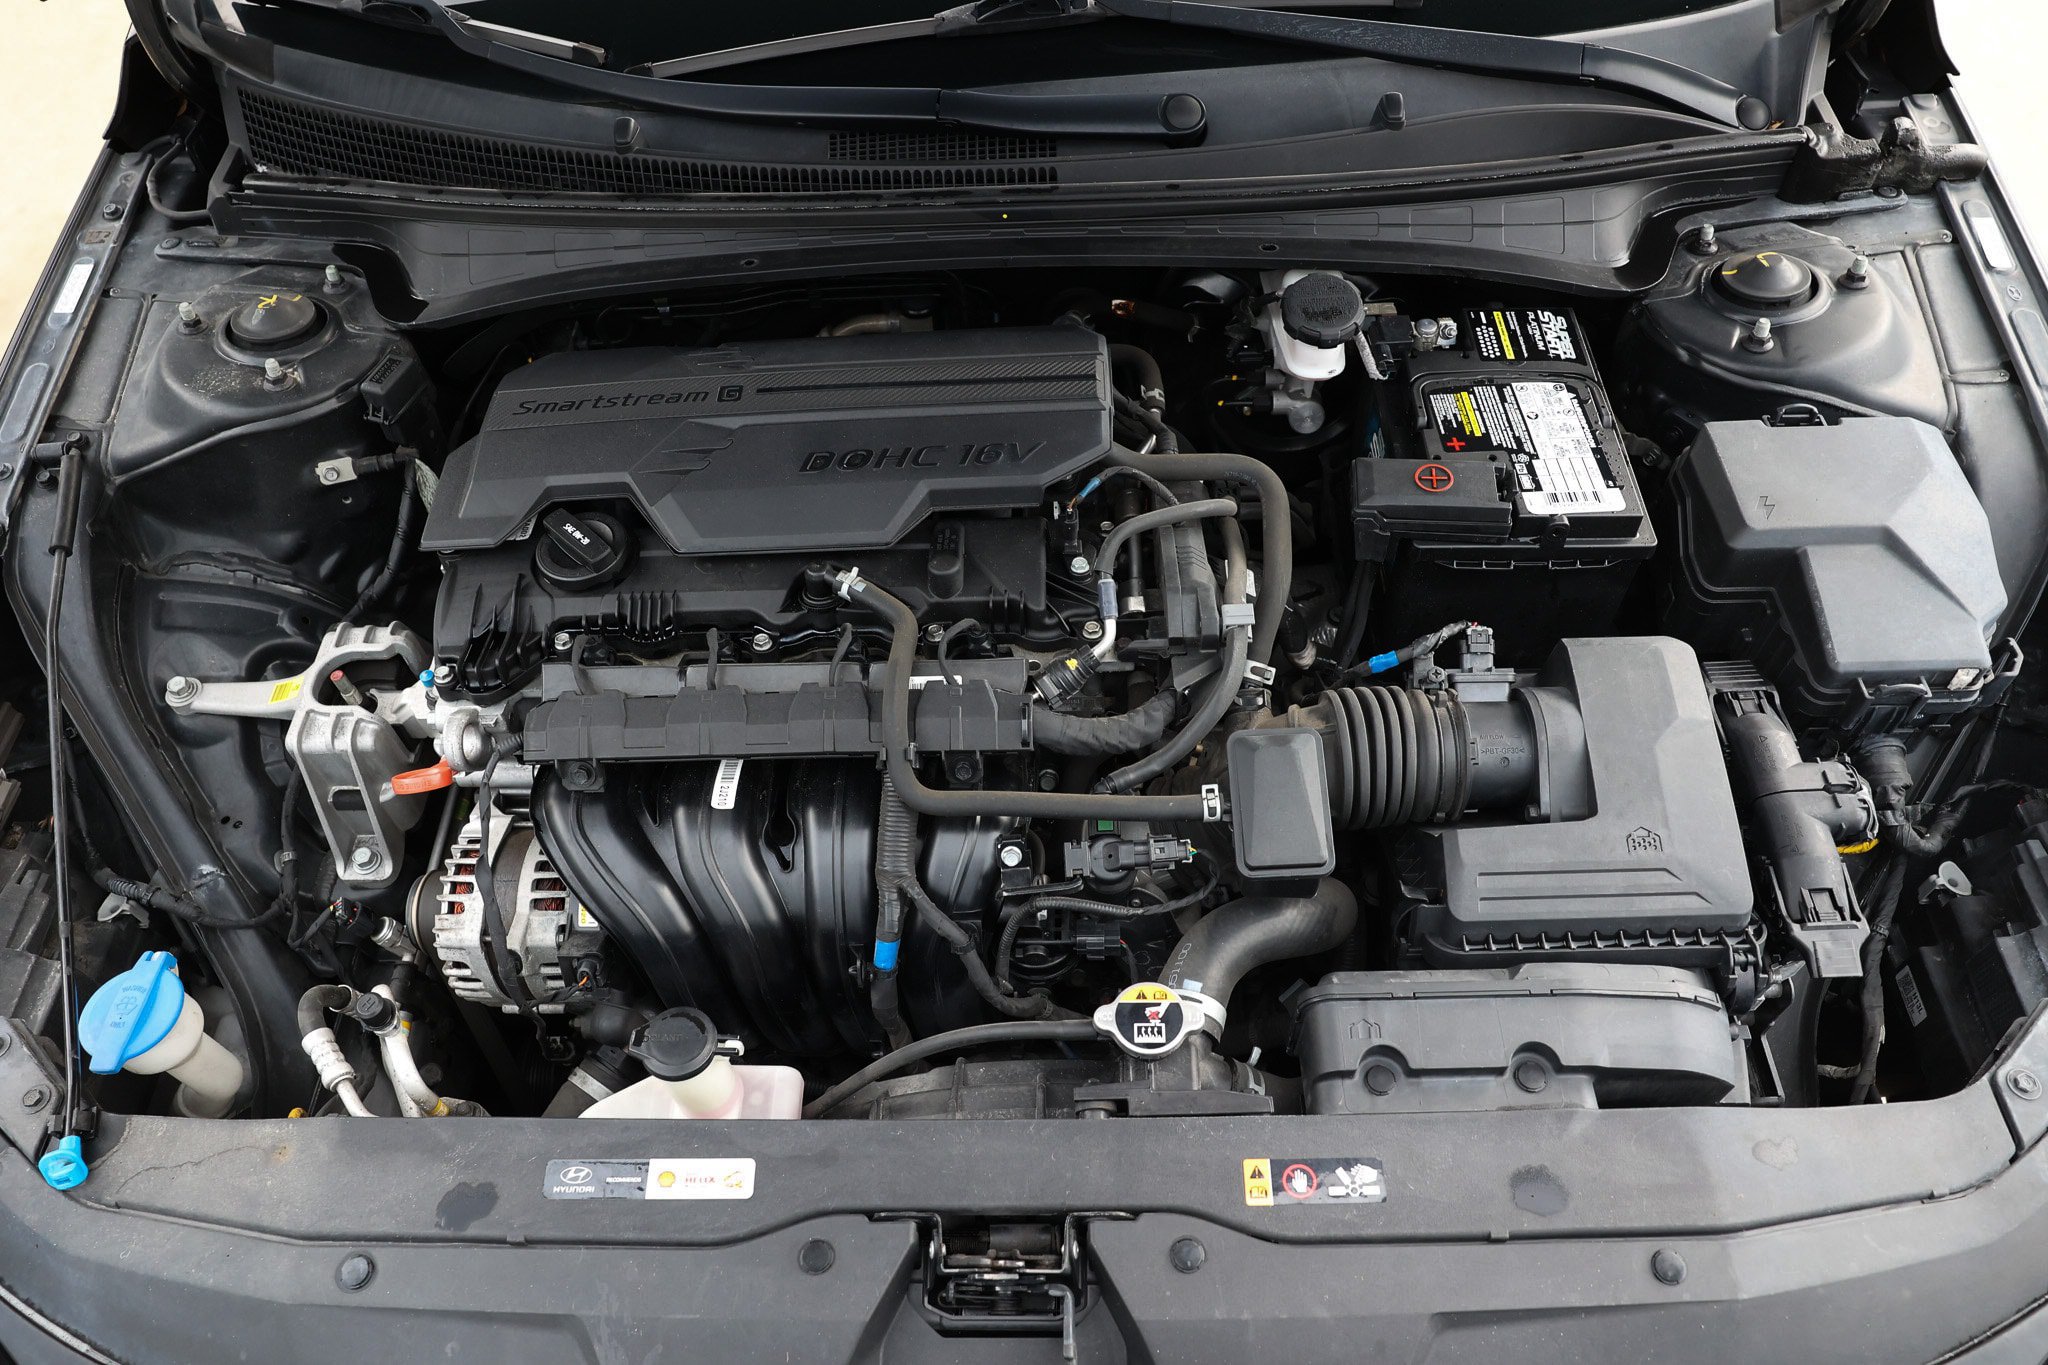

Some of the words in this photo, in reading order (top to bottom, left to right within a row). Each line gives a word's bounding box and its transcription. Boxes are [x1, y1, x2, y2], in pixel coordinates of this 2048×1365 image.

[1526, 311, 1546, 351] PLATINUM
[1537, 310, 1564, 359] START
[1555, 316, 1576, 360] SUPER
[512, 390, 709, 416] Smartstream
[800, 444, 949, 474] DOHC
[957, 440, 1048, 468] 16V
[563, 523, 577, 534] SAE
[553, 1185, 595, 1194] HYUNDAI
